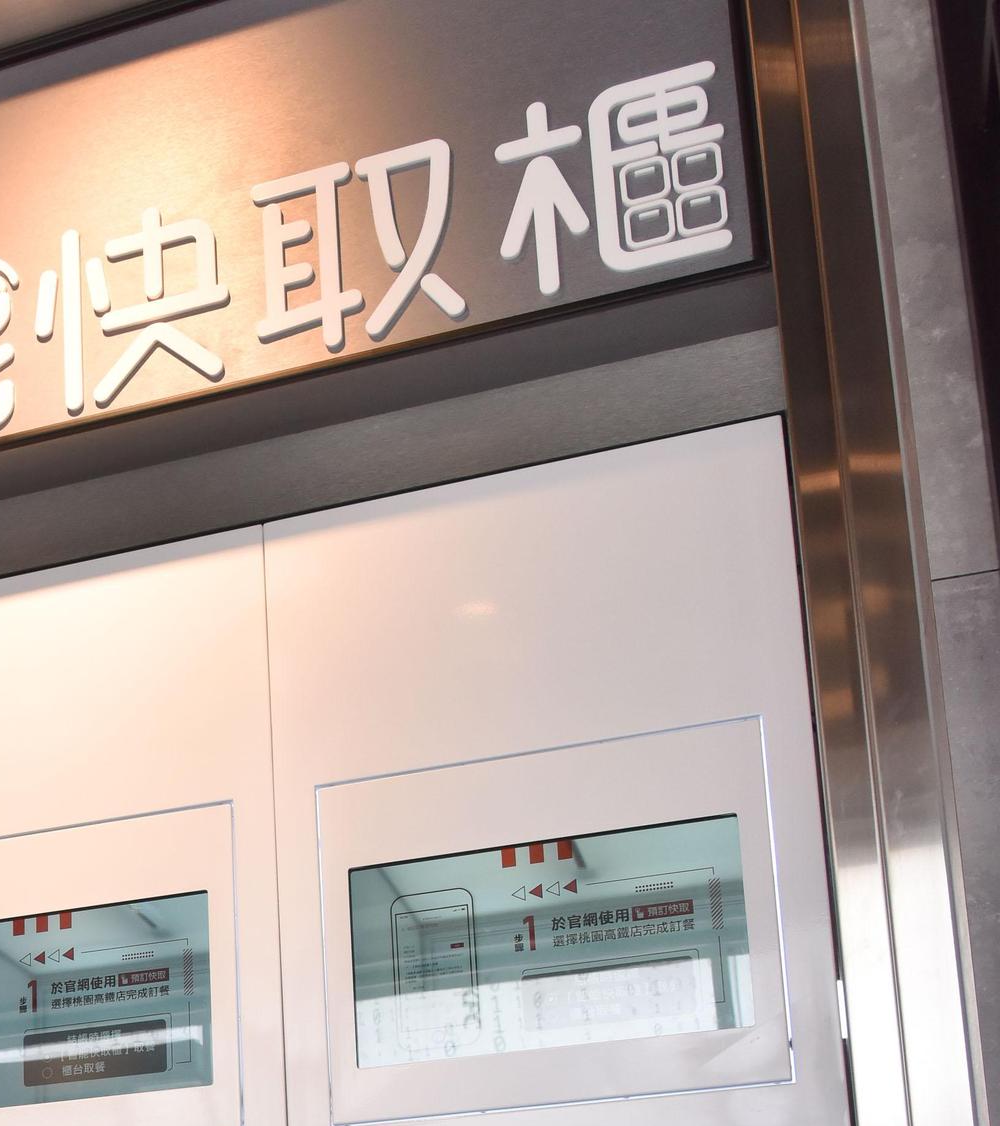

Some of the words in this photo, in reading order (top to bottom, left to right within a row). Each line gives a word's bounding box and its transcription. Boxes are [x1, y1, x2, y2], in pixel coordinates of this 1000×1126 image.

[522, 915, 536, 951] 1
[551, 908, 630, 931] 於官網使用
[27, 979, 38, 1013] 1
[50, 975, 117, 995] 於官網使用
